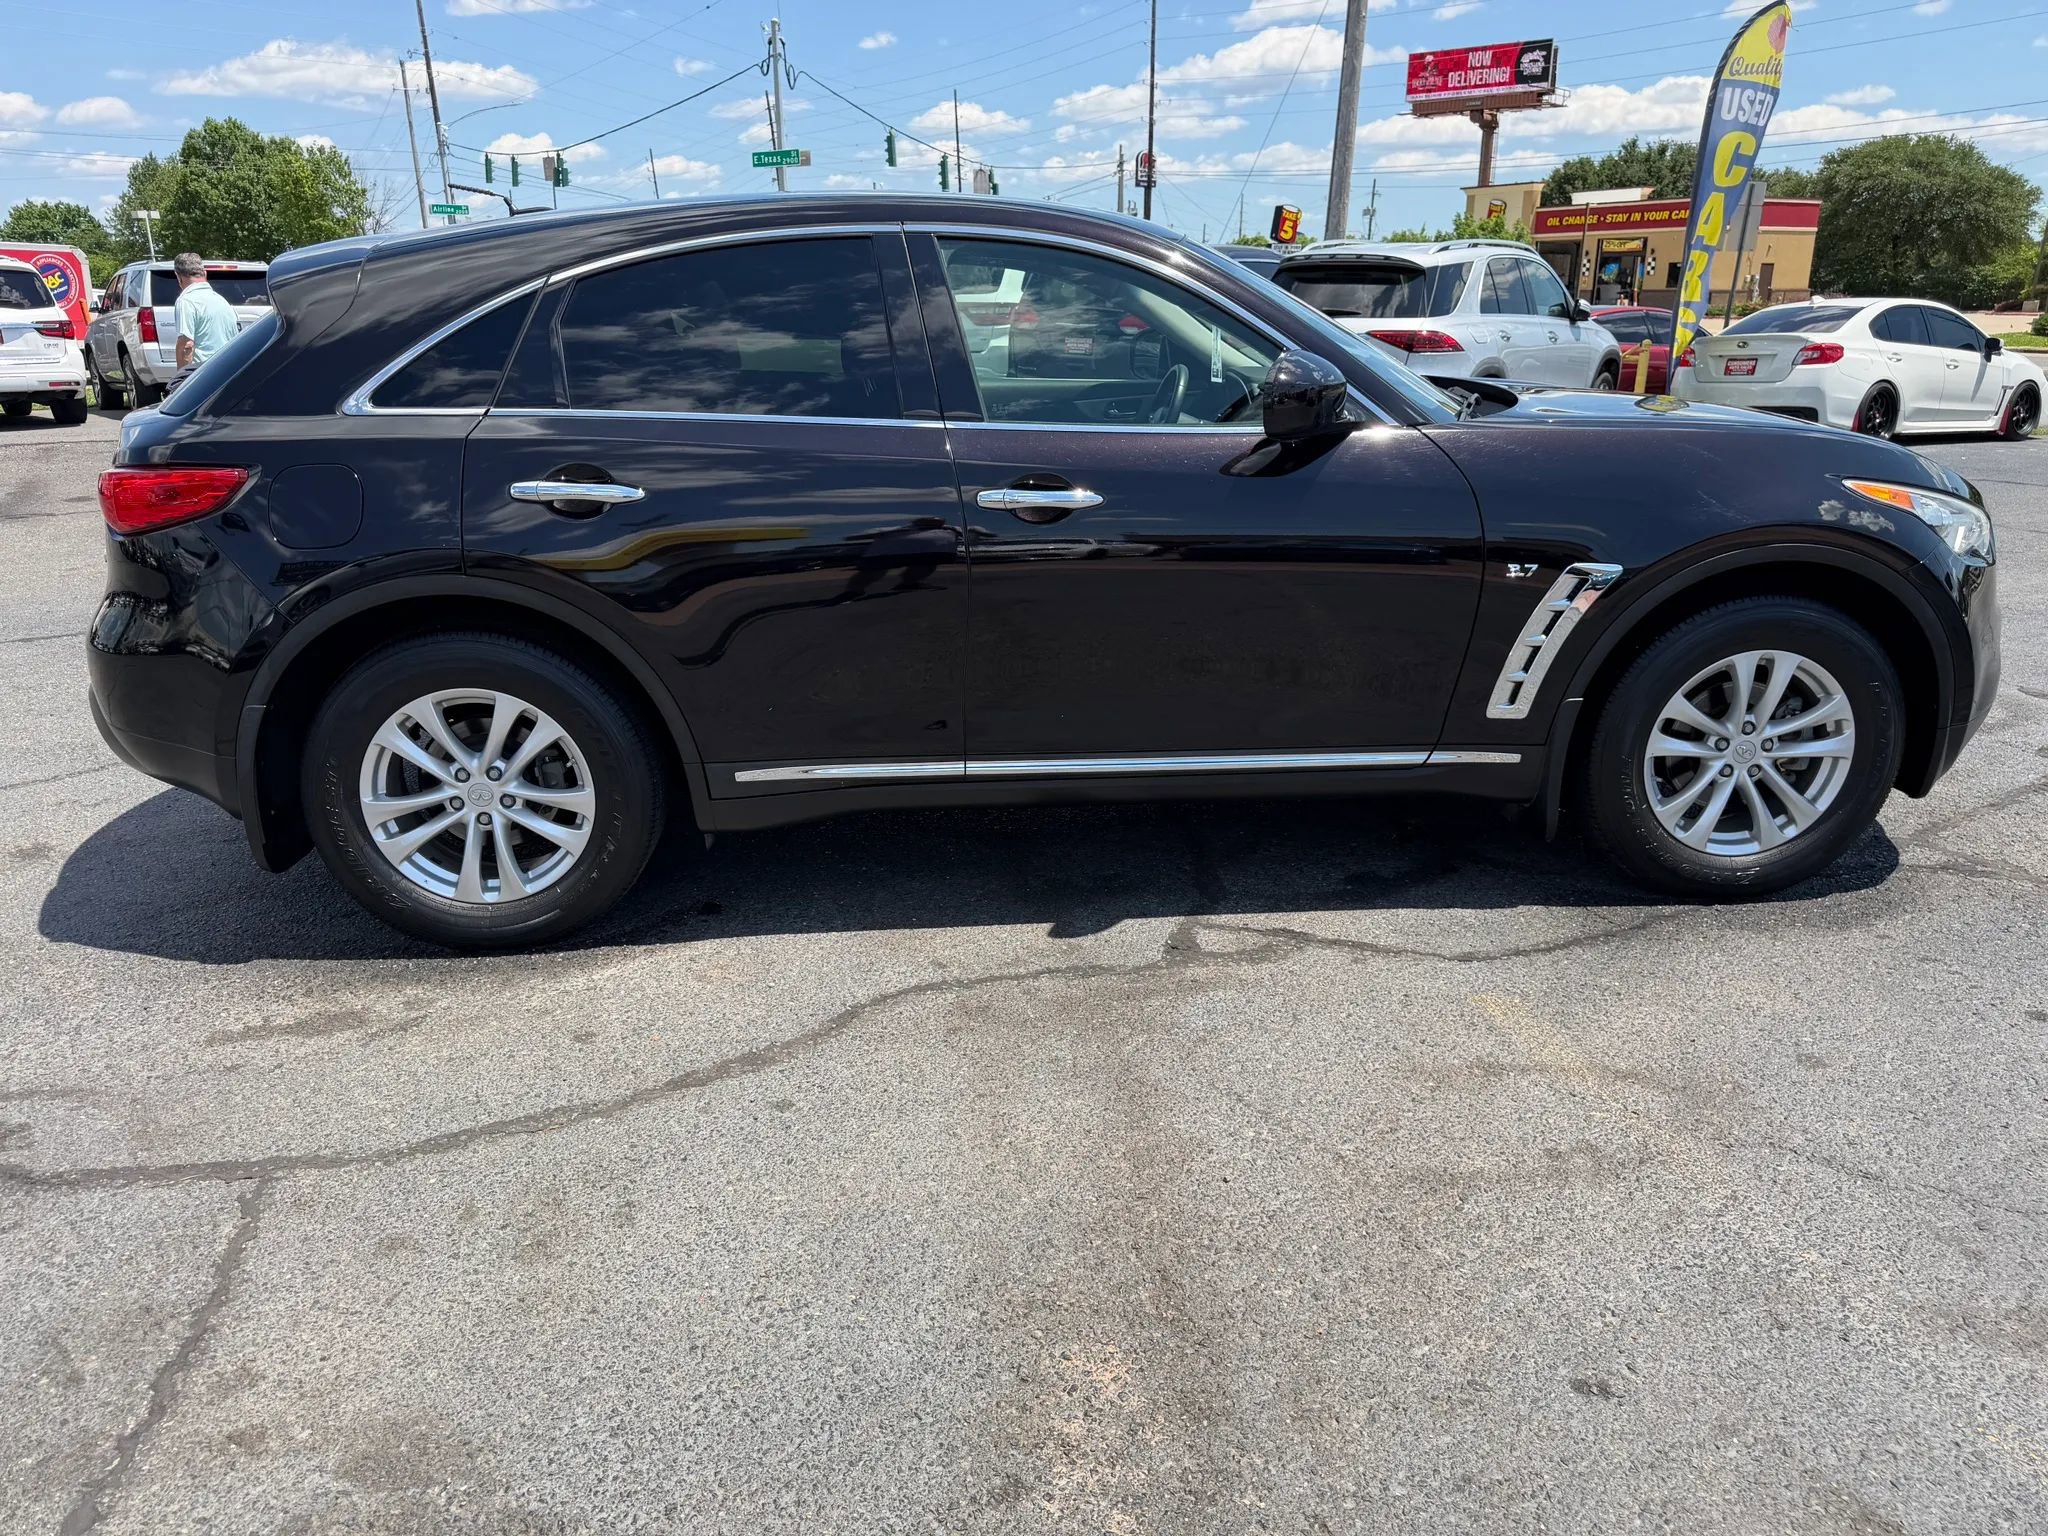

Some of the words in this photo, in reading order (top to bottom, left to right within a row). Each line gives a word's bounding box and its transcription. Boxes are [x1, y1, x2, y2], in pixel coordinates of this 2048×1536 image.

[1468, 51, 1492, 67] NOW
[1729, 55, 1782, 81] Quality
[1448, 67, 1510, 87] DELIVERING!
[1720, 88, 1774, 126] USED
[1282, 210, 1297, 220] TAKE
[1547, 217, 1560, 226] OIL
[1563, 215, 1599, 225] CHANGE
[1606, 213, 1629, 223] STAY
[1630, 212, 1642, 221] IN
[1644, 211, 1670, 221] YOUR
[1280, 220, 1293, 240] 5
